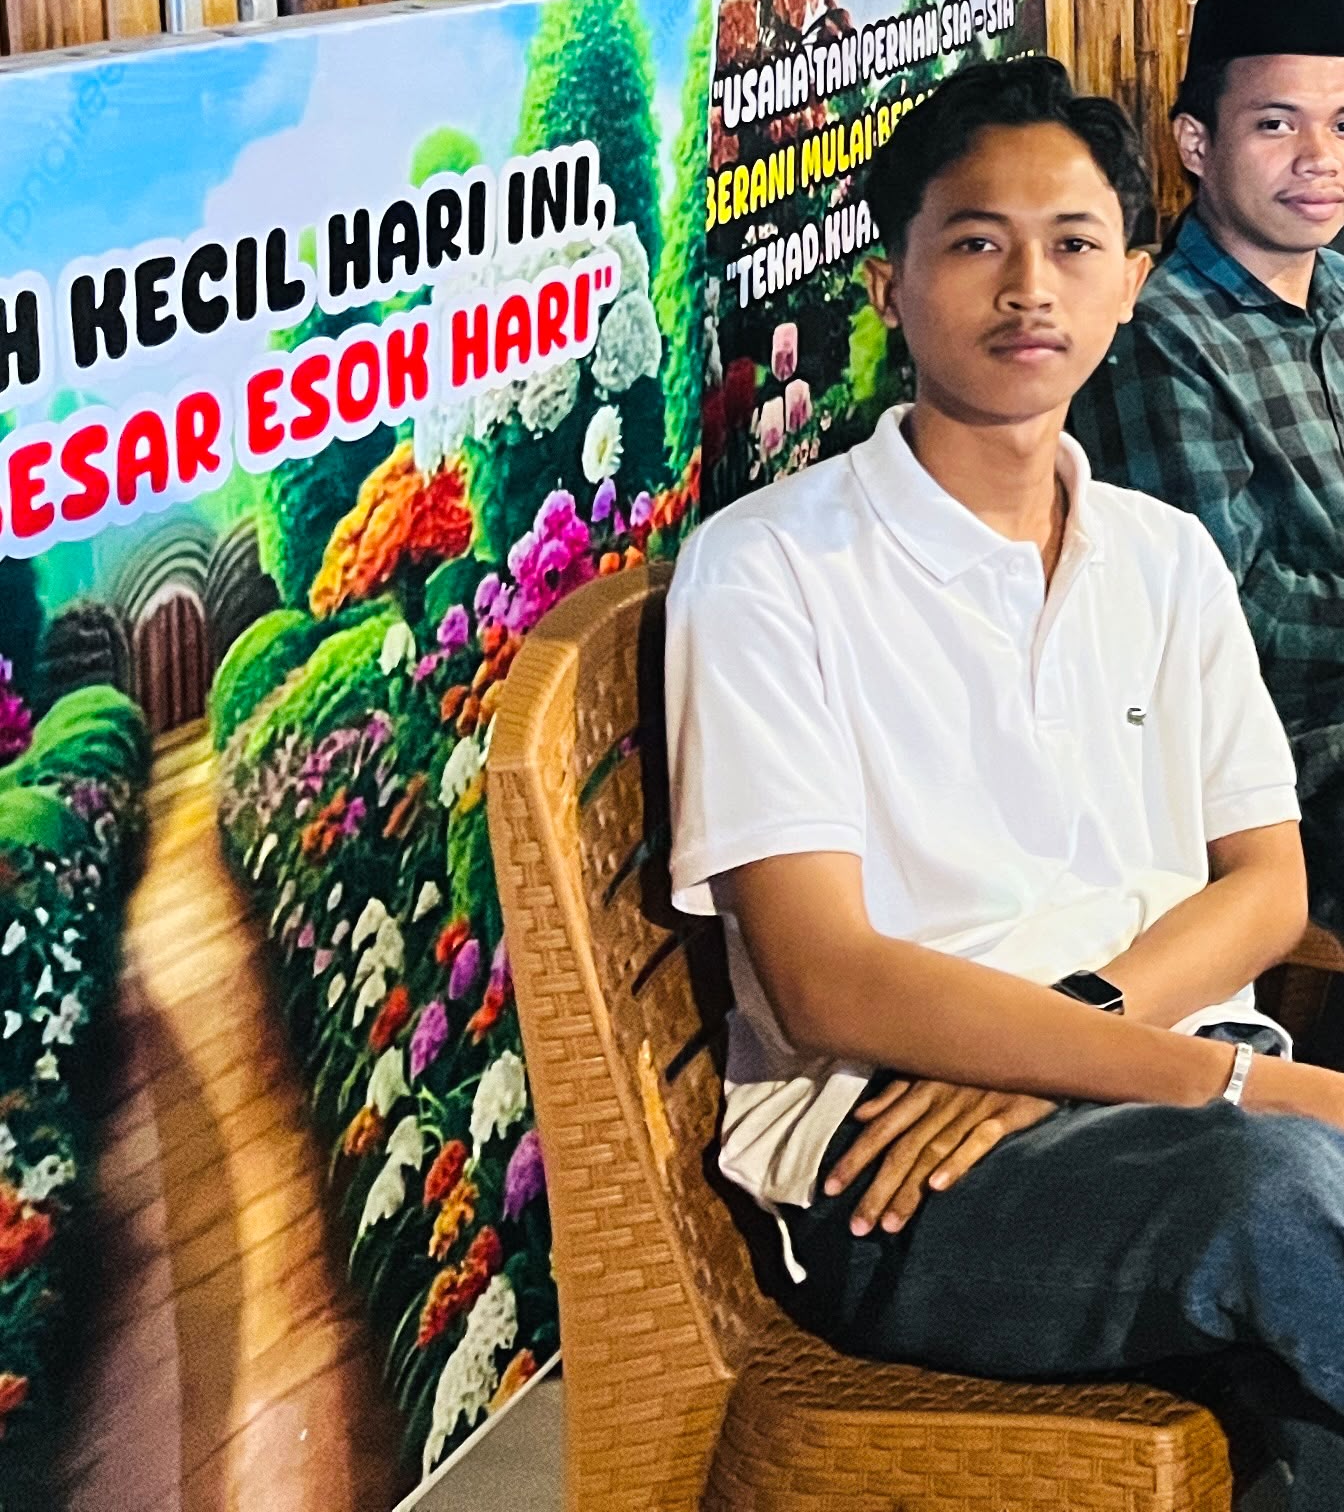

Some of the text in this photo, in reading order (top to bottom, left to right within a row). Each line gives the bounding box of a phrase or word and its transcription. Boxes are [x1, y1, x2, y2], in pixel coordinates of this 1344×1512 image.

[713, 52, 810, 128] "USAHA
[812, 35, 858, 97] TAK
[862, 9, 939, 79] PERNAH
[801, 114, 872, 189] MULAI
[70, 227, 306, 368] KECIL
[327, 180, 487, 296] HARI
[507, 155, 607, 244] INI,
[726, 222, 819, 308] "TEKAD
[0, 265, 612, 538] ESAR ESOK HARI"
